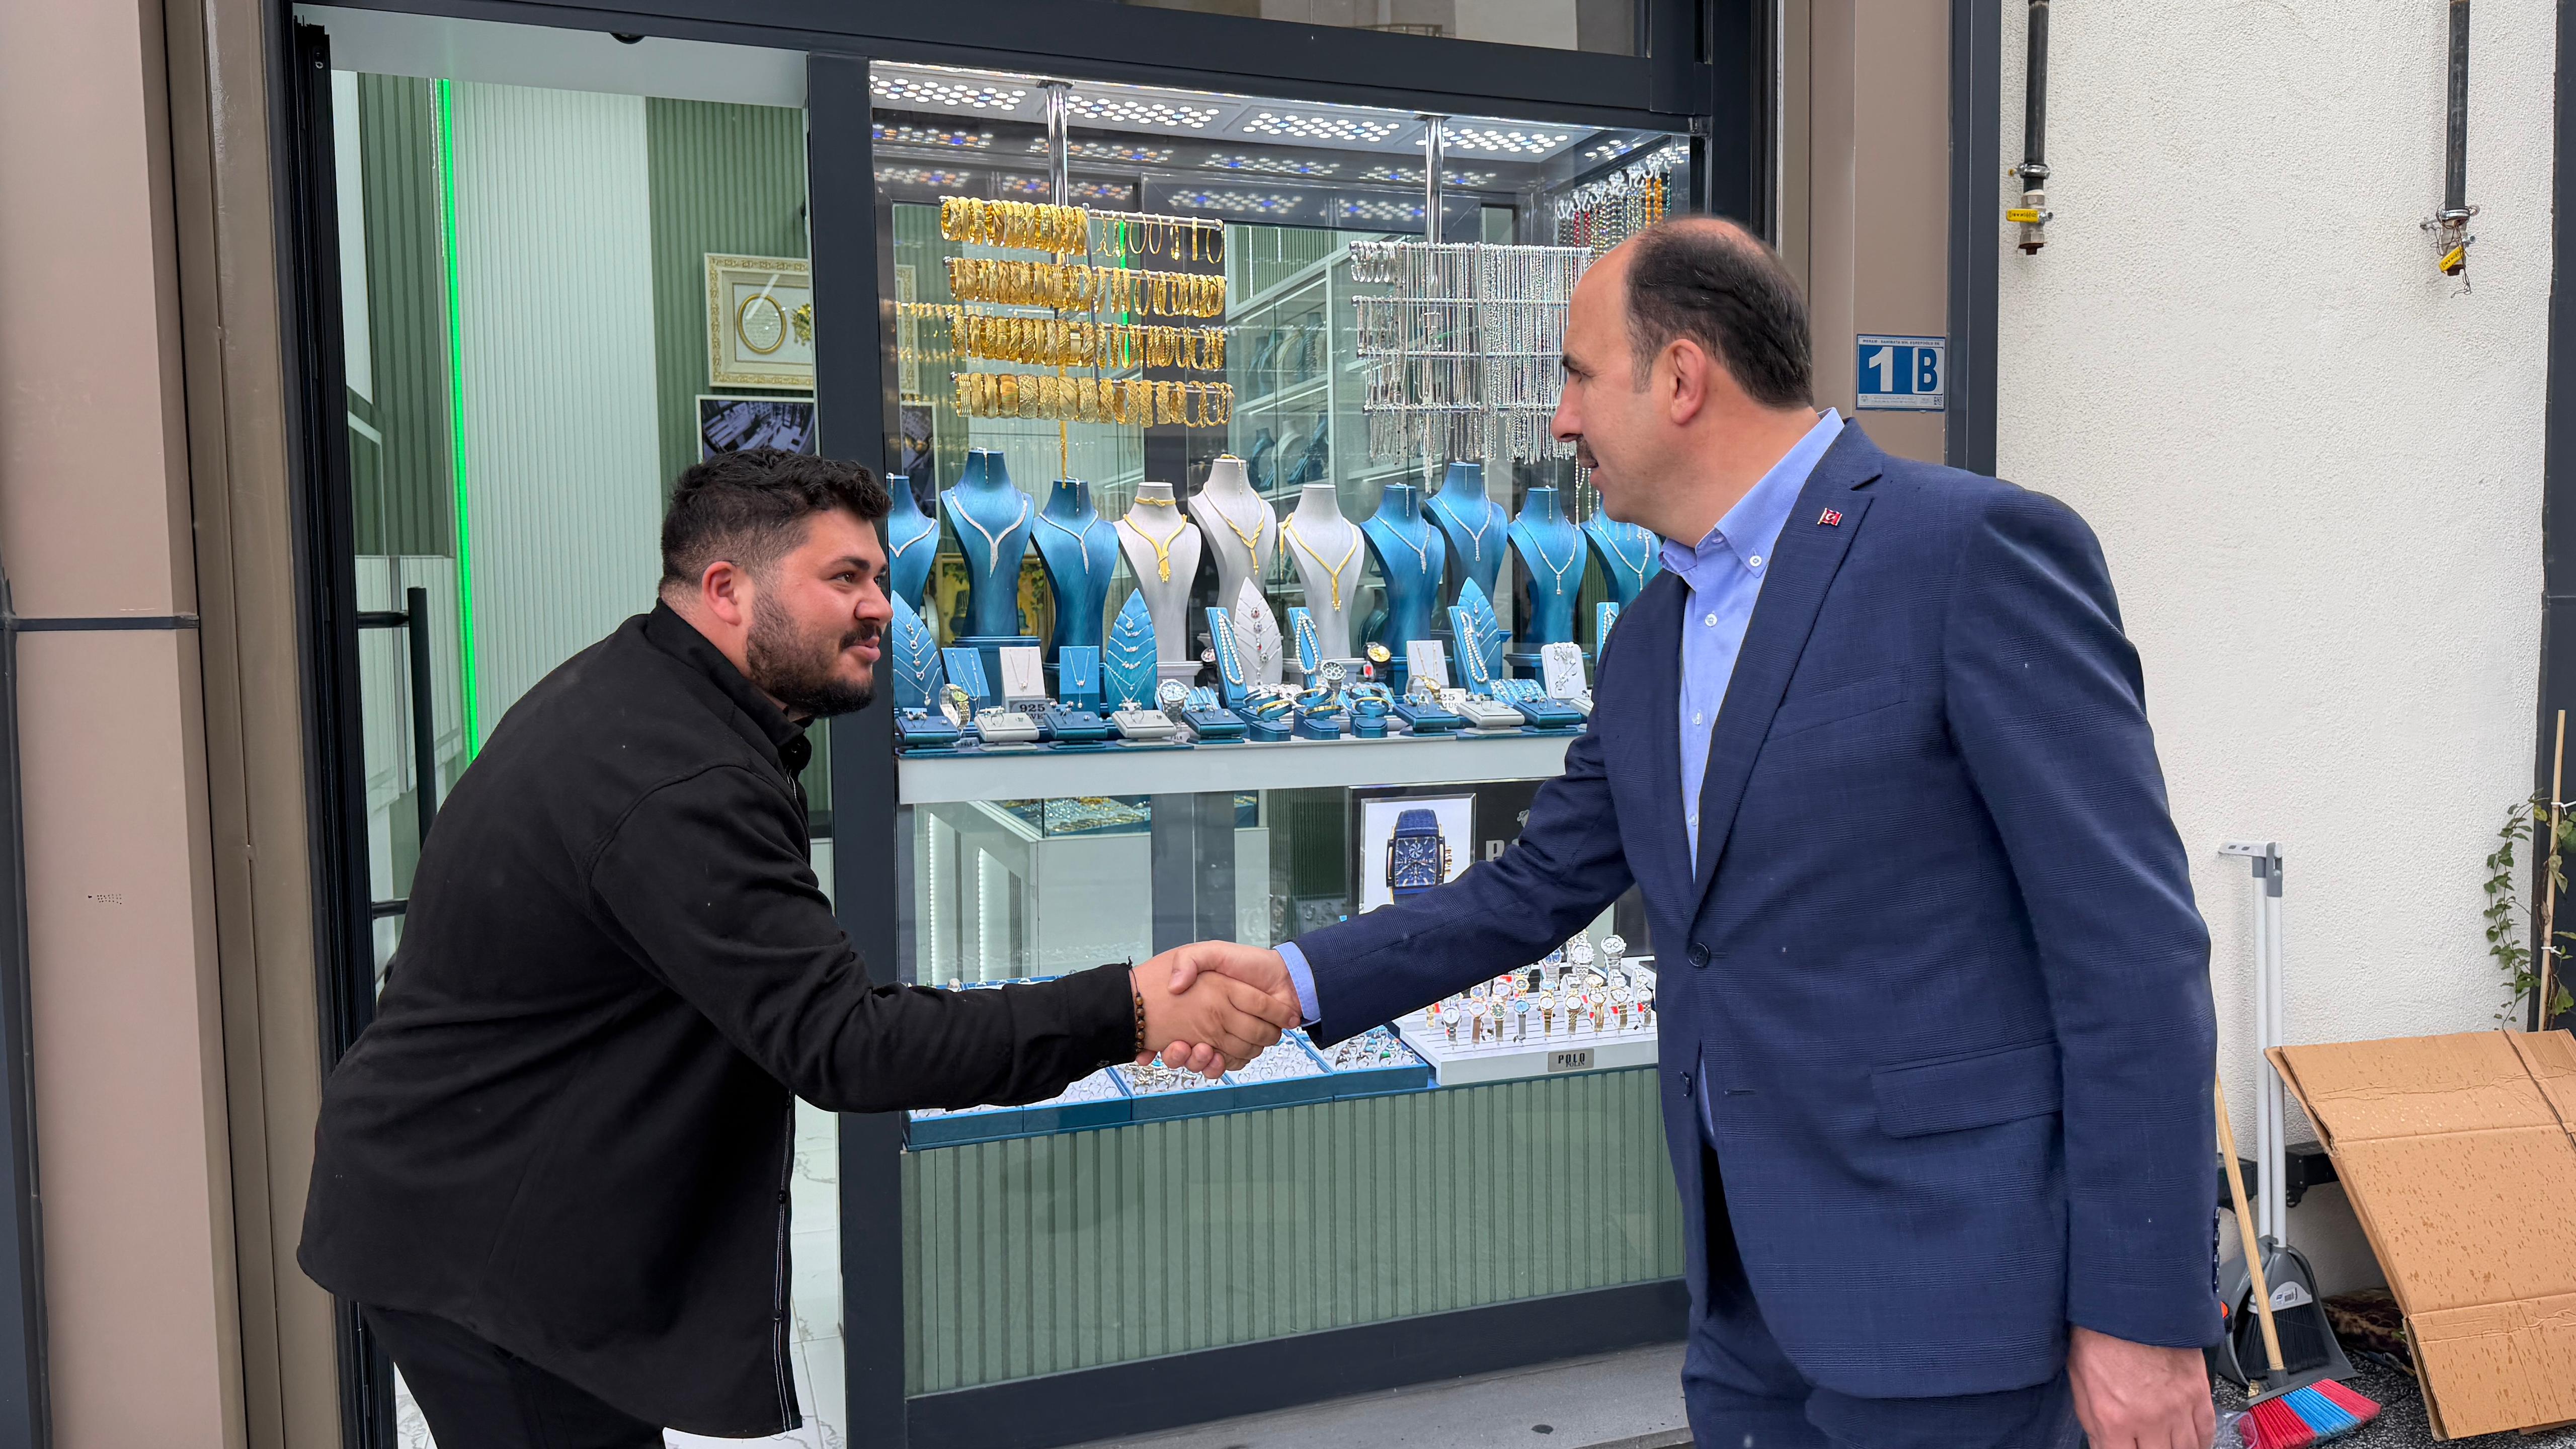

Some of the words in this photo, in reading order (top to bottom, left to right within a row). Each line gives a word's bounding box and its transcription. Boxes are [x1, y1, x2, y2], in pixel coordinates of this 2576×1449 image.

[1869, 346, 1893, 392] 1
[1917, 348, 1938, 392] B
[1019, 704, 1045, 712] 925
[1558, 1053, 1585, 1064] POLO
